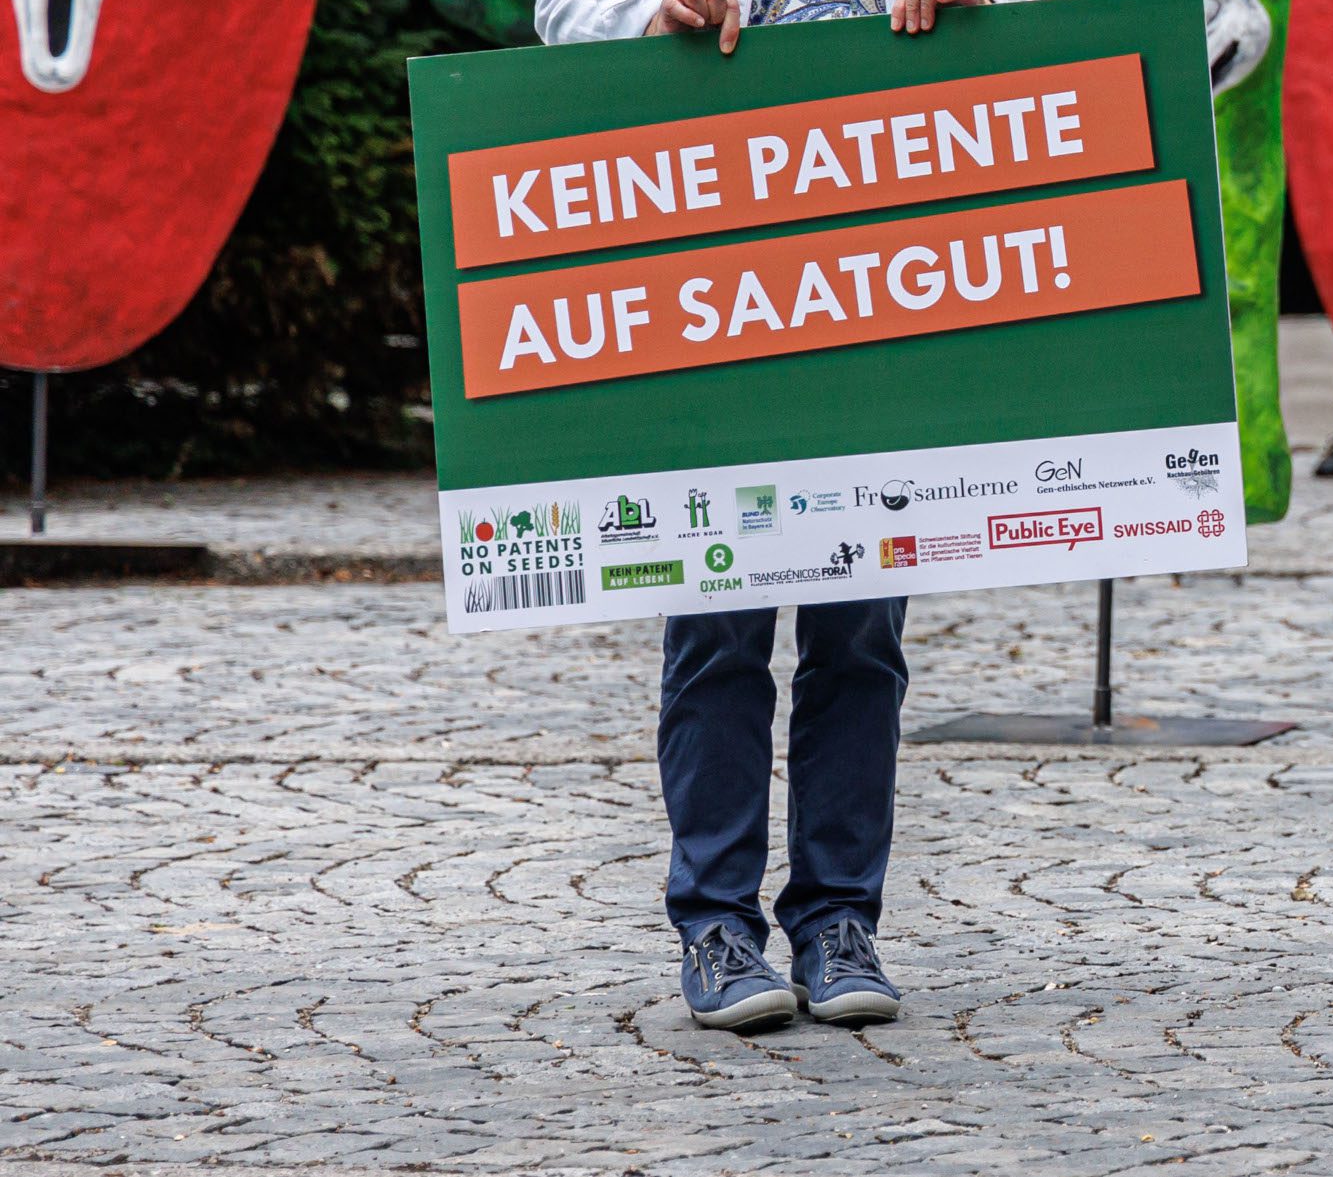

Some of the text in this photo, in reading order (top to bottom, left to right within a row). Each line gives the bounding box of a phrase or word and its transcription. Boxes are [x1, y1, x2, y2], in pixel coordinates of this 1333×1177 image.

[493, 91, 1083, 237] KEINE PATENTE
[500, 226, 1070, 369] AUF SAATGUT!
[1165, 448, 1219, 469] Gegen
[1035, 458, 1083, 483] GeN
[1037, 476, 1156, 494] Gen-ethisches Netzwerk e.V.
[995, 517, 1096, 541] Public Eye
[1114, 519, 1193, 538] SWISSAID
[461, 536, 583, 560] NO PATENTS
[894, 547, 905, 555] pro
[462, 553, 584, 576] ON SEEDS!
[609, 564, 674, 577] KEIN PATENT
[610, 578, 629, 587] AUF
[700, 577, 743, 593] OXFAM
[748, 568, 821, 583] TRANSGÉNICOS
